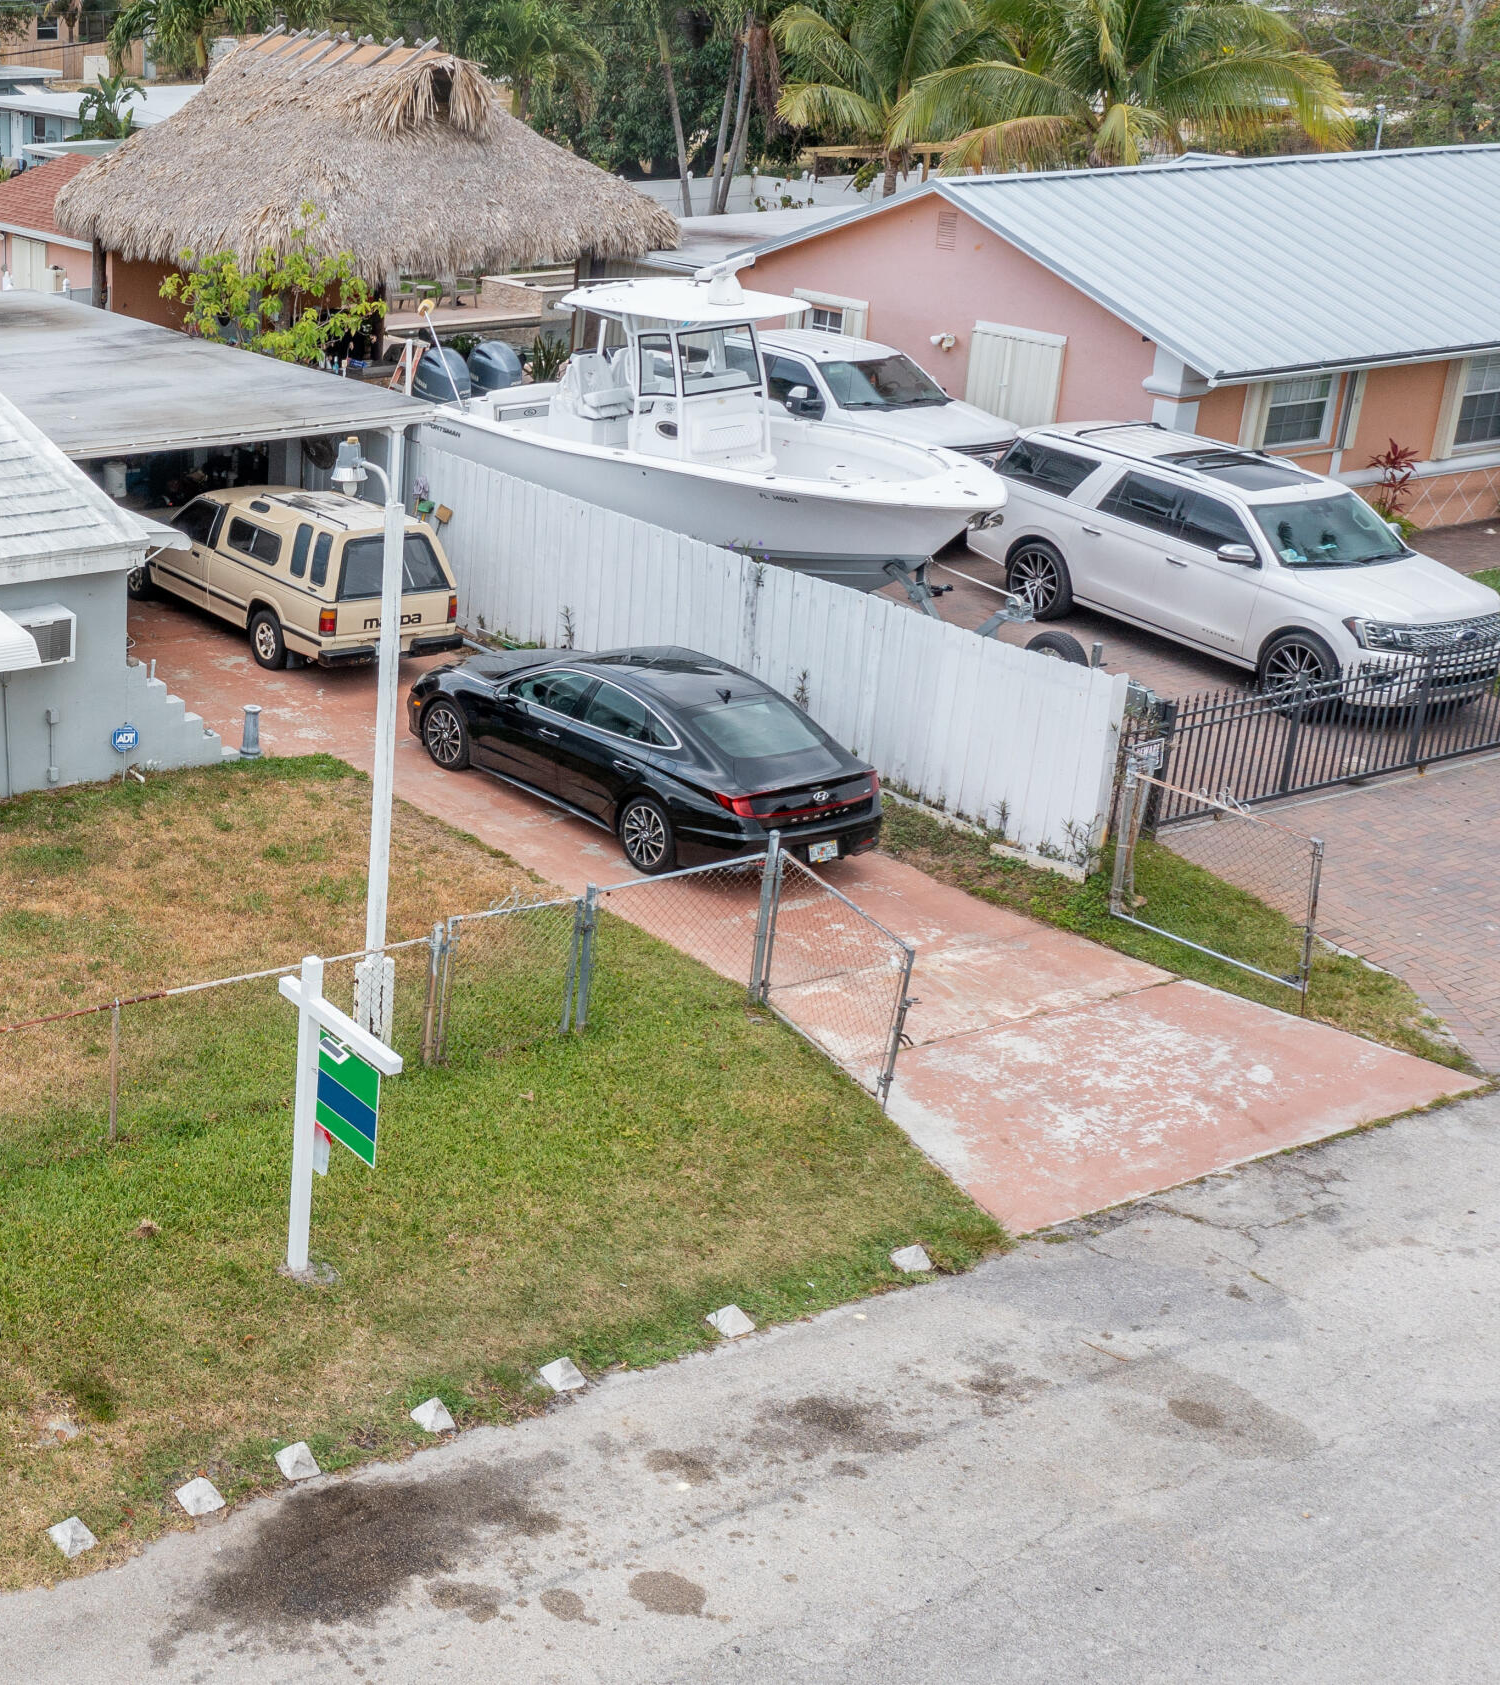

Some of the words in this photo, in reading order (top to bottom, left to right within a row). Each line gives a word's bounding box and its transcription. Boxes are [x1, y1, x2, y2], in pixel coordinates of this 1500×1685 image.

[363, 613, 422, 630] mda
[116, 733, 135, 743] ADT
[791, 807, 849, 823] SONATA
